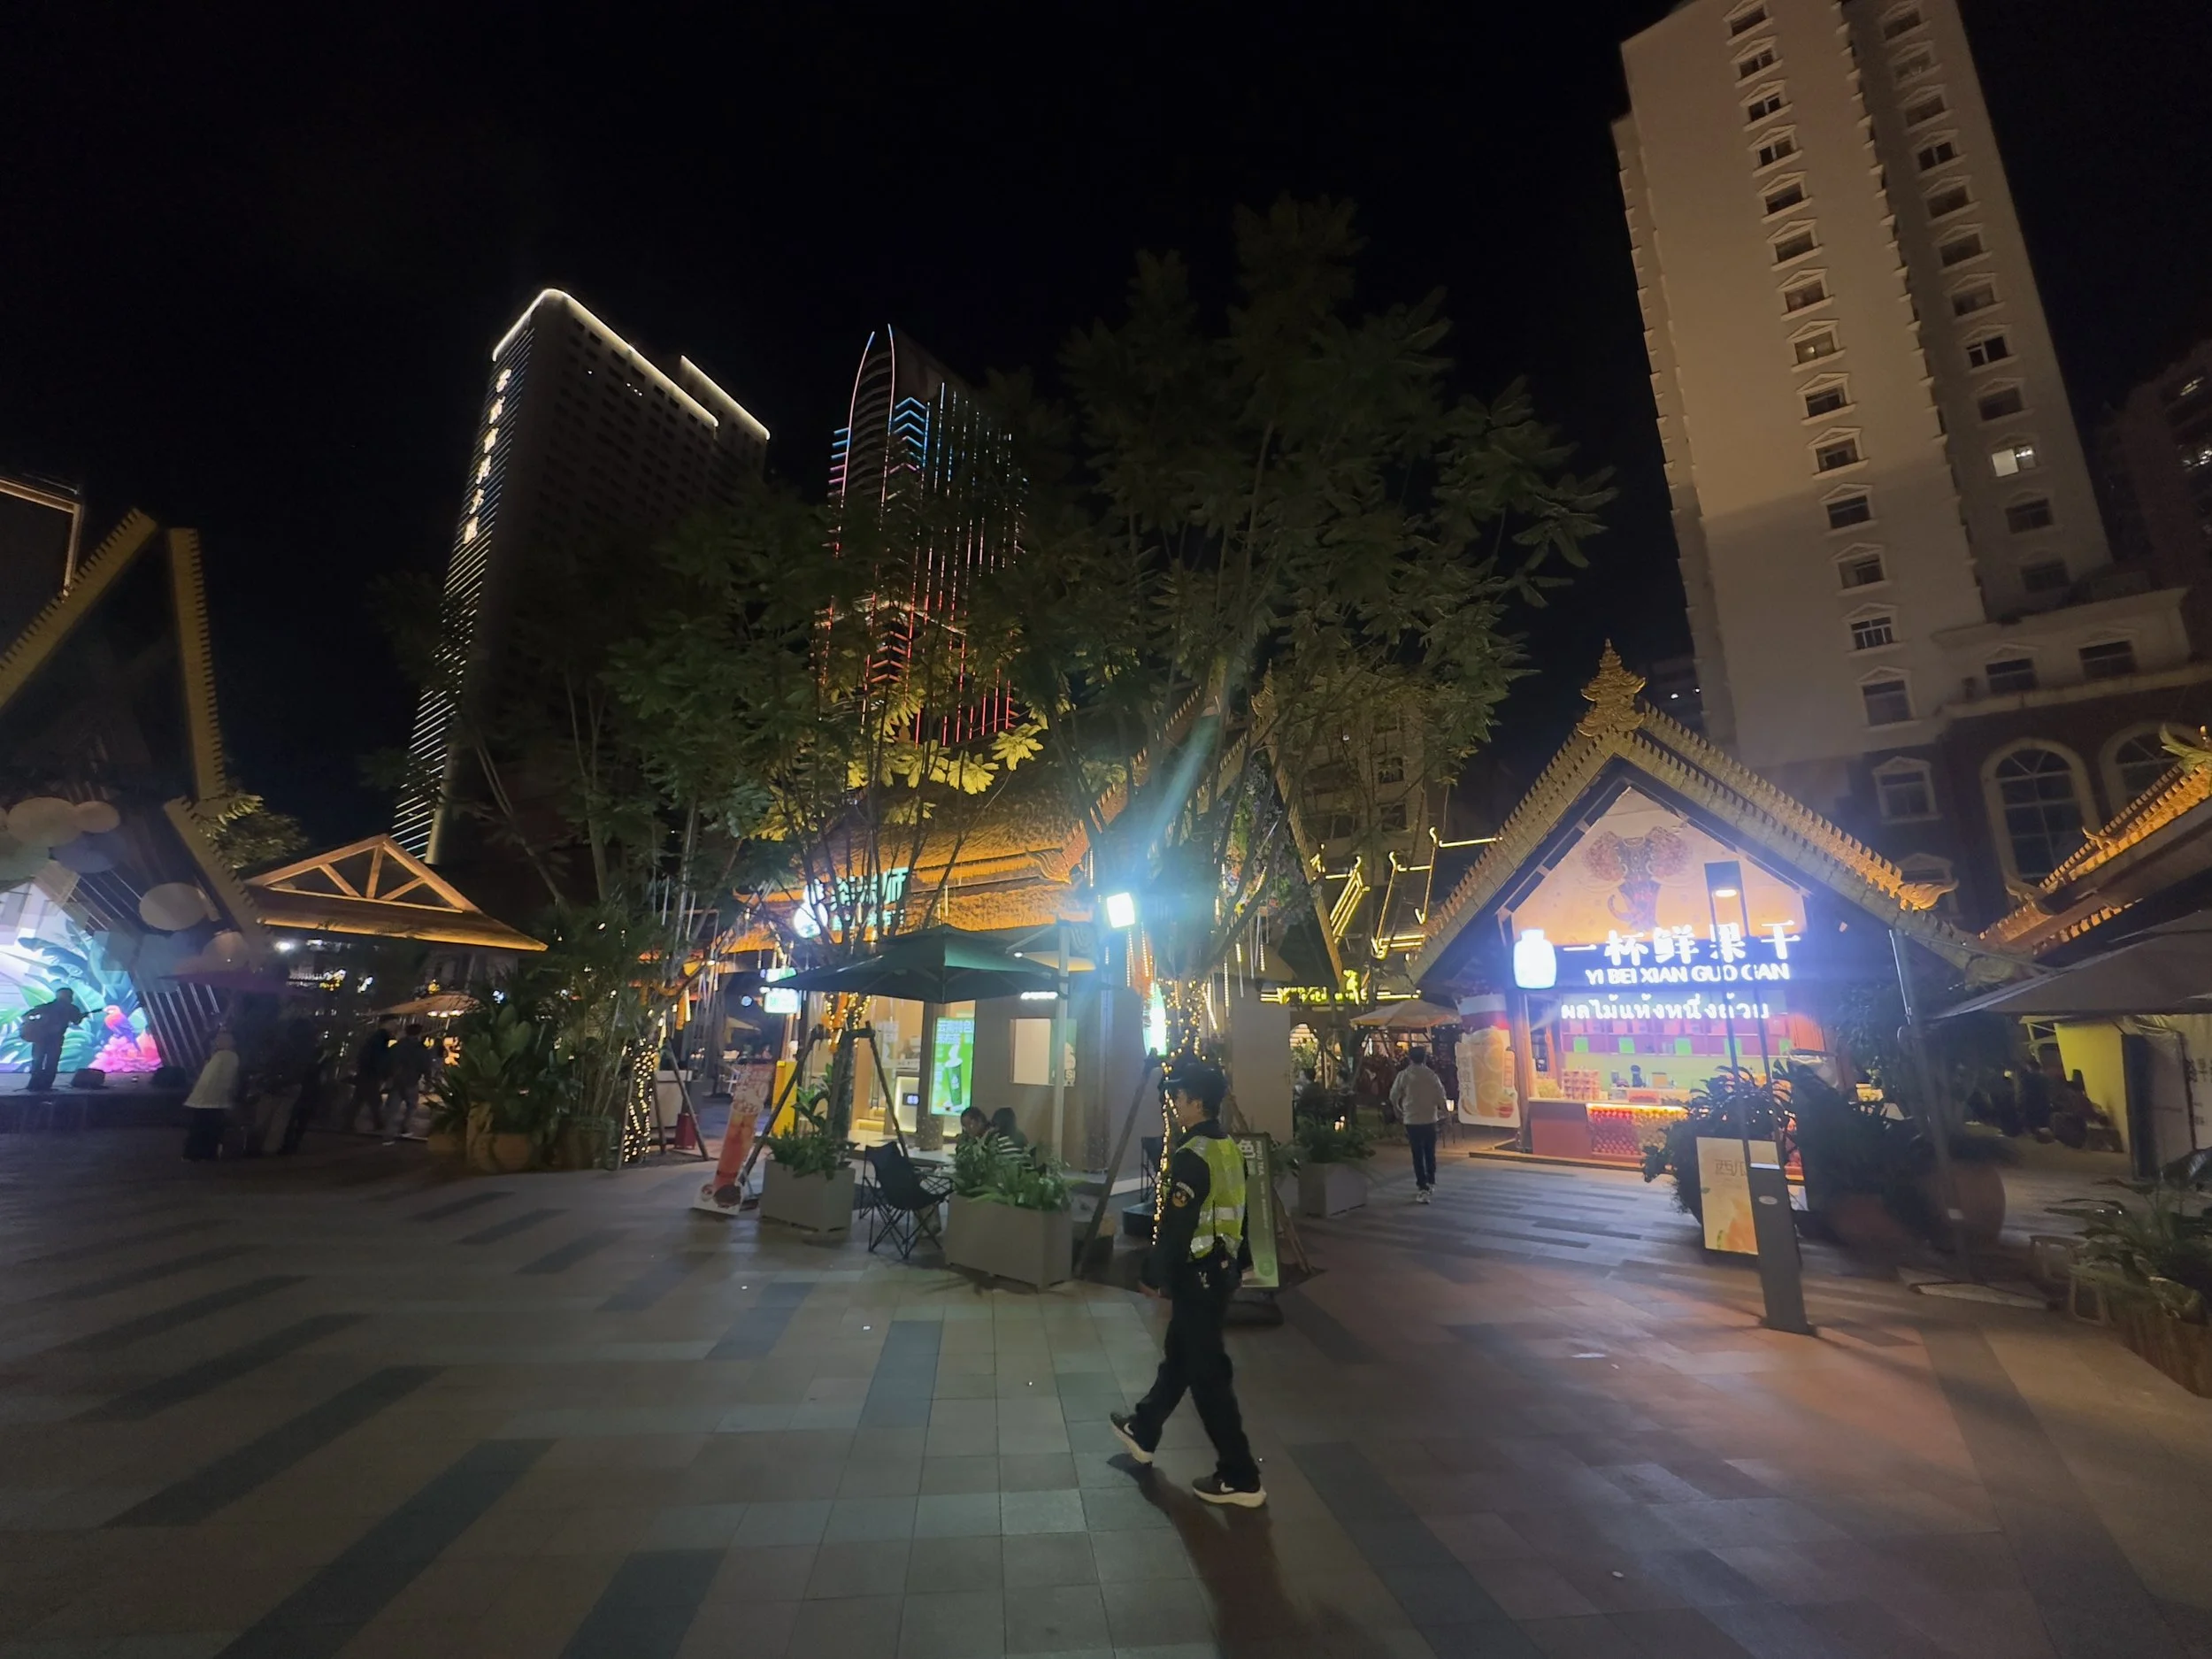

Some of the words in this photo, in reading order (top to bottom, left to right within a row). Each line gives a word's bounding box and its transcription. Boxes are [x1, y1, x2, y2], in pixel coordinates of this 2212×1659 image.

[1563, 920, 1801, 967] 一杯鲜果干
[1585, 969, 1604, 986] YI
[1607, 967, 1637, 985] BEI
[1640, 965, 1689, 984] XIAN
